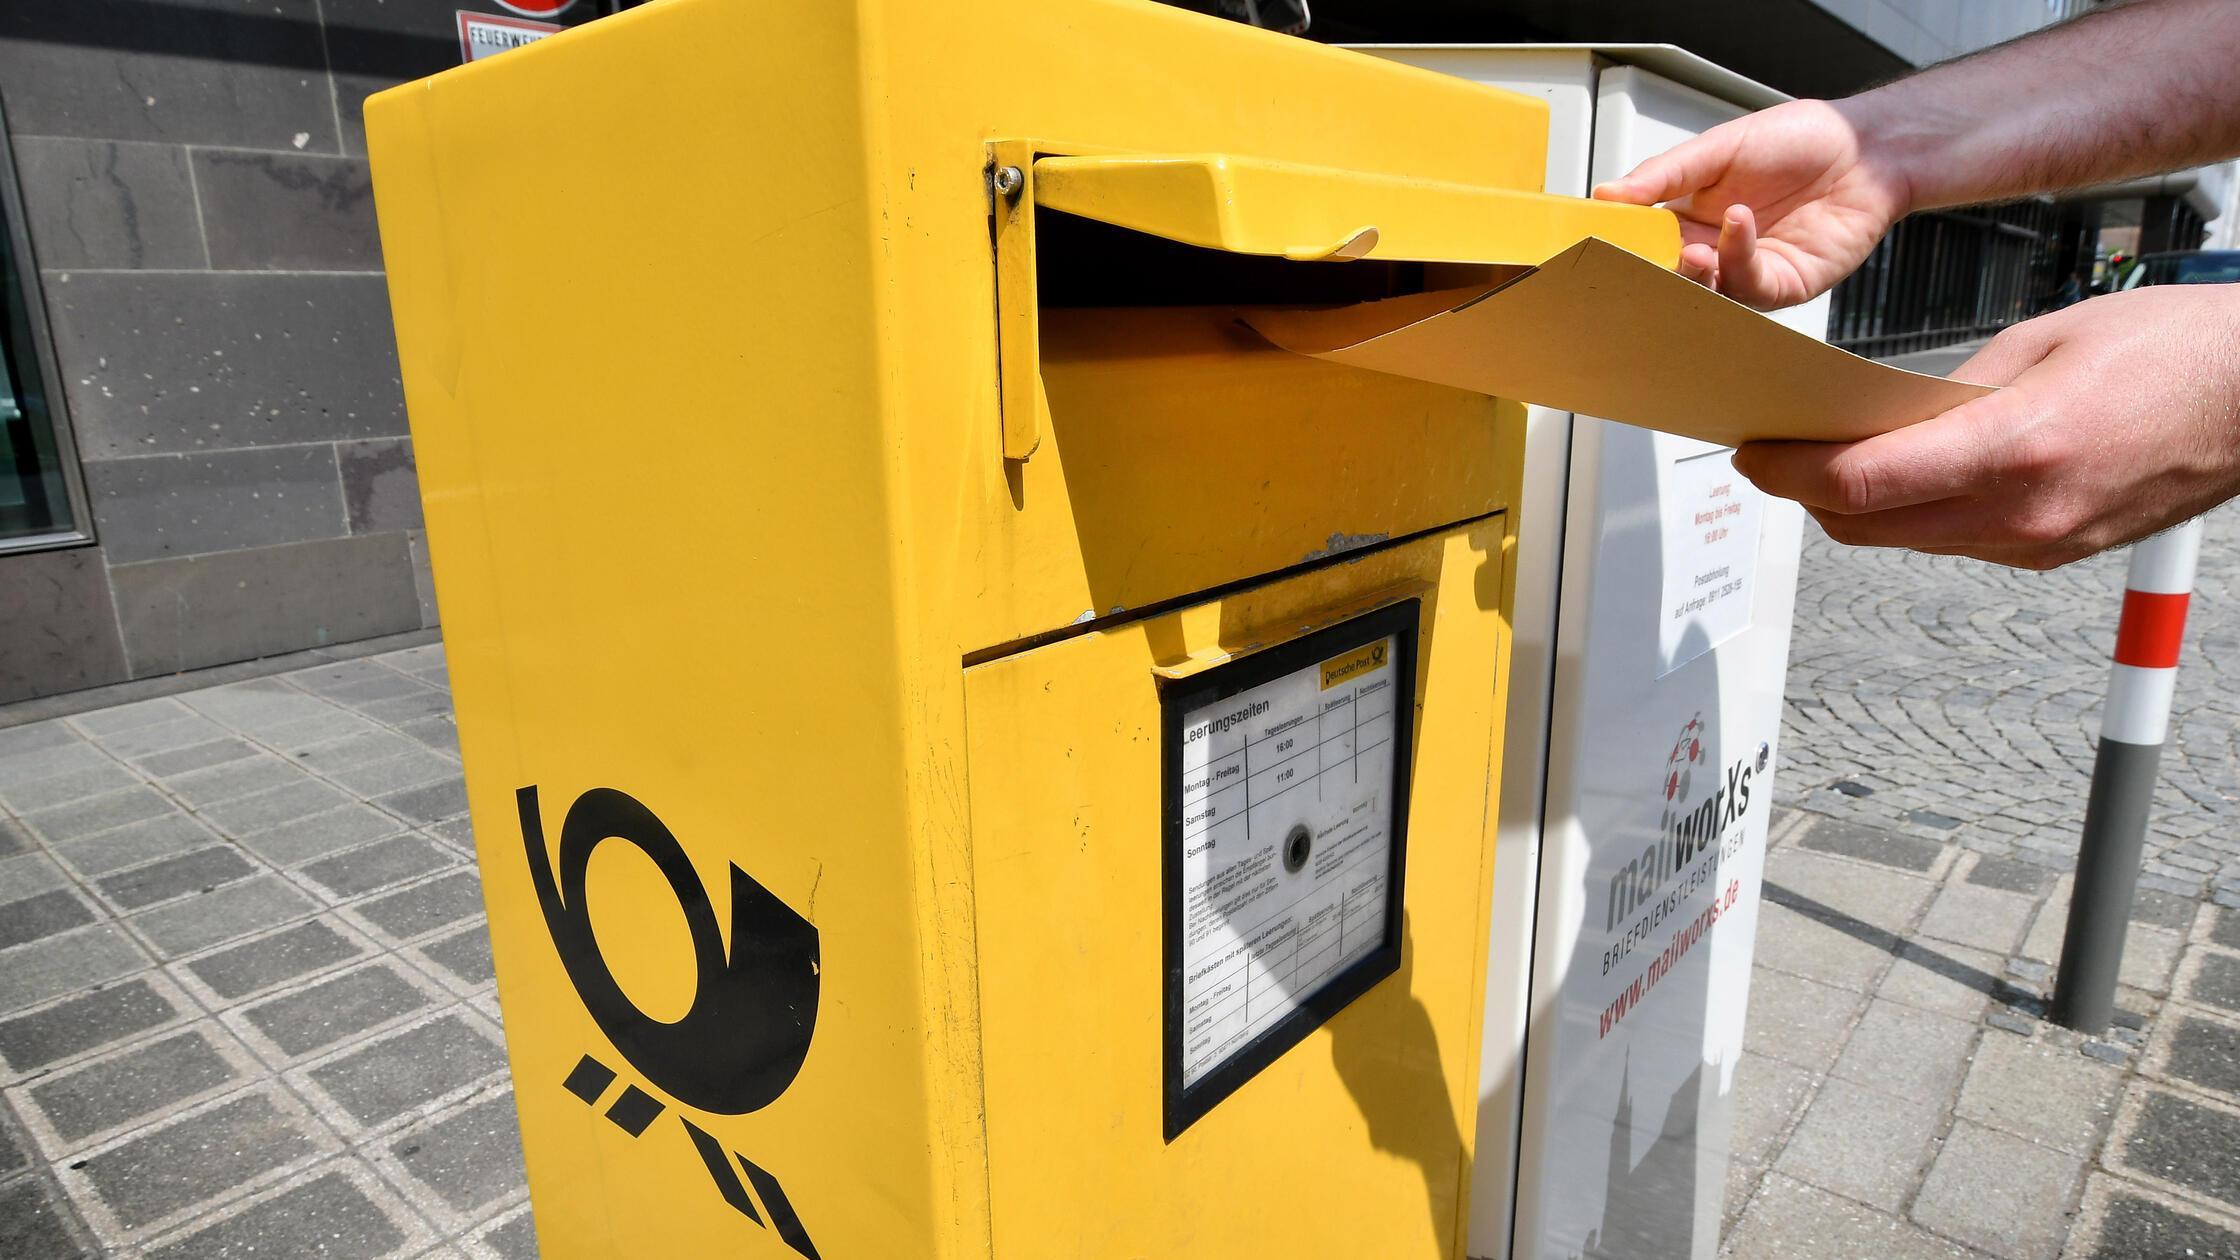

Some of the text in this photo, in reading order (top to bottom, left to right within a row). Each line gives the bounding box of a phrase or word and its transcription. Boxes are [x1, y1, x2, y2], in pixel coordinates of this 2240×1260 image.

[1695, 511, 1714, 525] Montag
[1694, 565, 1730, 588] Postabholung
[1326, 656, 1370, 681] Deutsche Post
[1264, 715, 1304, 737] Tagesleerungen
[1276, 738, 1294, 753] 16:00
[1184, 777, 1211, 795] Montag
[1216, 765, 1240, 781] Freitag
[1277, 767, 1294, 784] 11:00
[1185, 807, 1216, 827] Samstag
[1187, 839, 1216, 859] Sonntag
[1606, 759, 1752, 934] mailworXs
[1188, 876, 1216, 895] Sendungen
[1254, 850, 1262, 860] und
[1602, 826, 1747, 977] BRIEFDIENSTLEISTUNGEN
[1188, 958, 1224, 985] Briefkästen
[1225, 950, 1235, 962] mit
[1236, 936, 1261, 955] späteren
[1599, 878, 1740, 1040] www.mailworxs.de
[1189, 997, 1209, 1015] Montag
[1213, 984, 1232, 999] Freitag
[1189, 1015, 1212, 1035] Samstag
[1189, 1036, 1211, 1055] Sonntag
